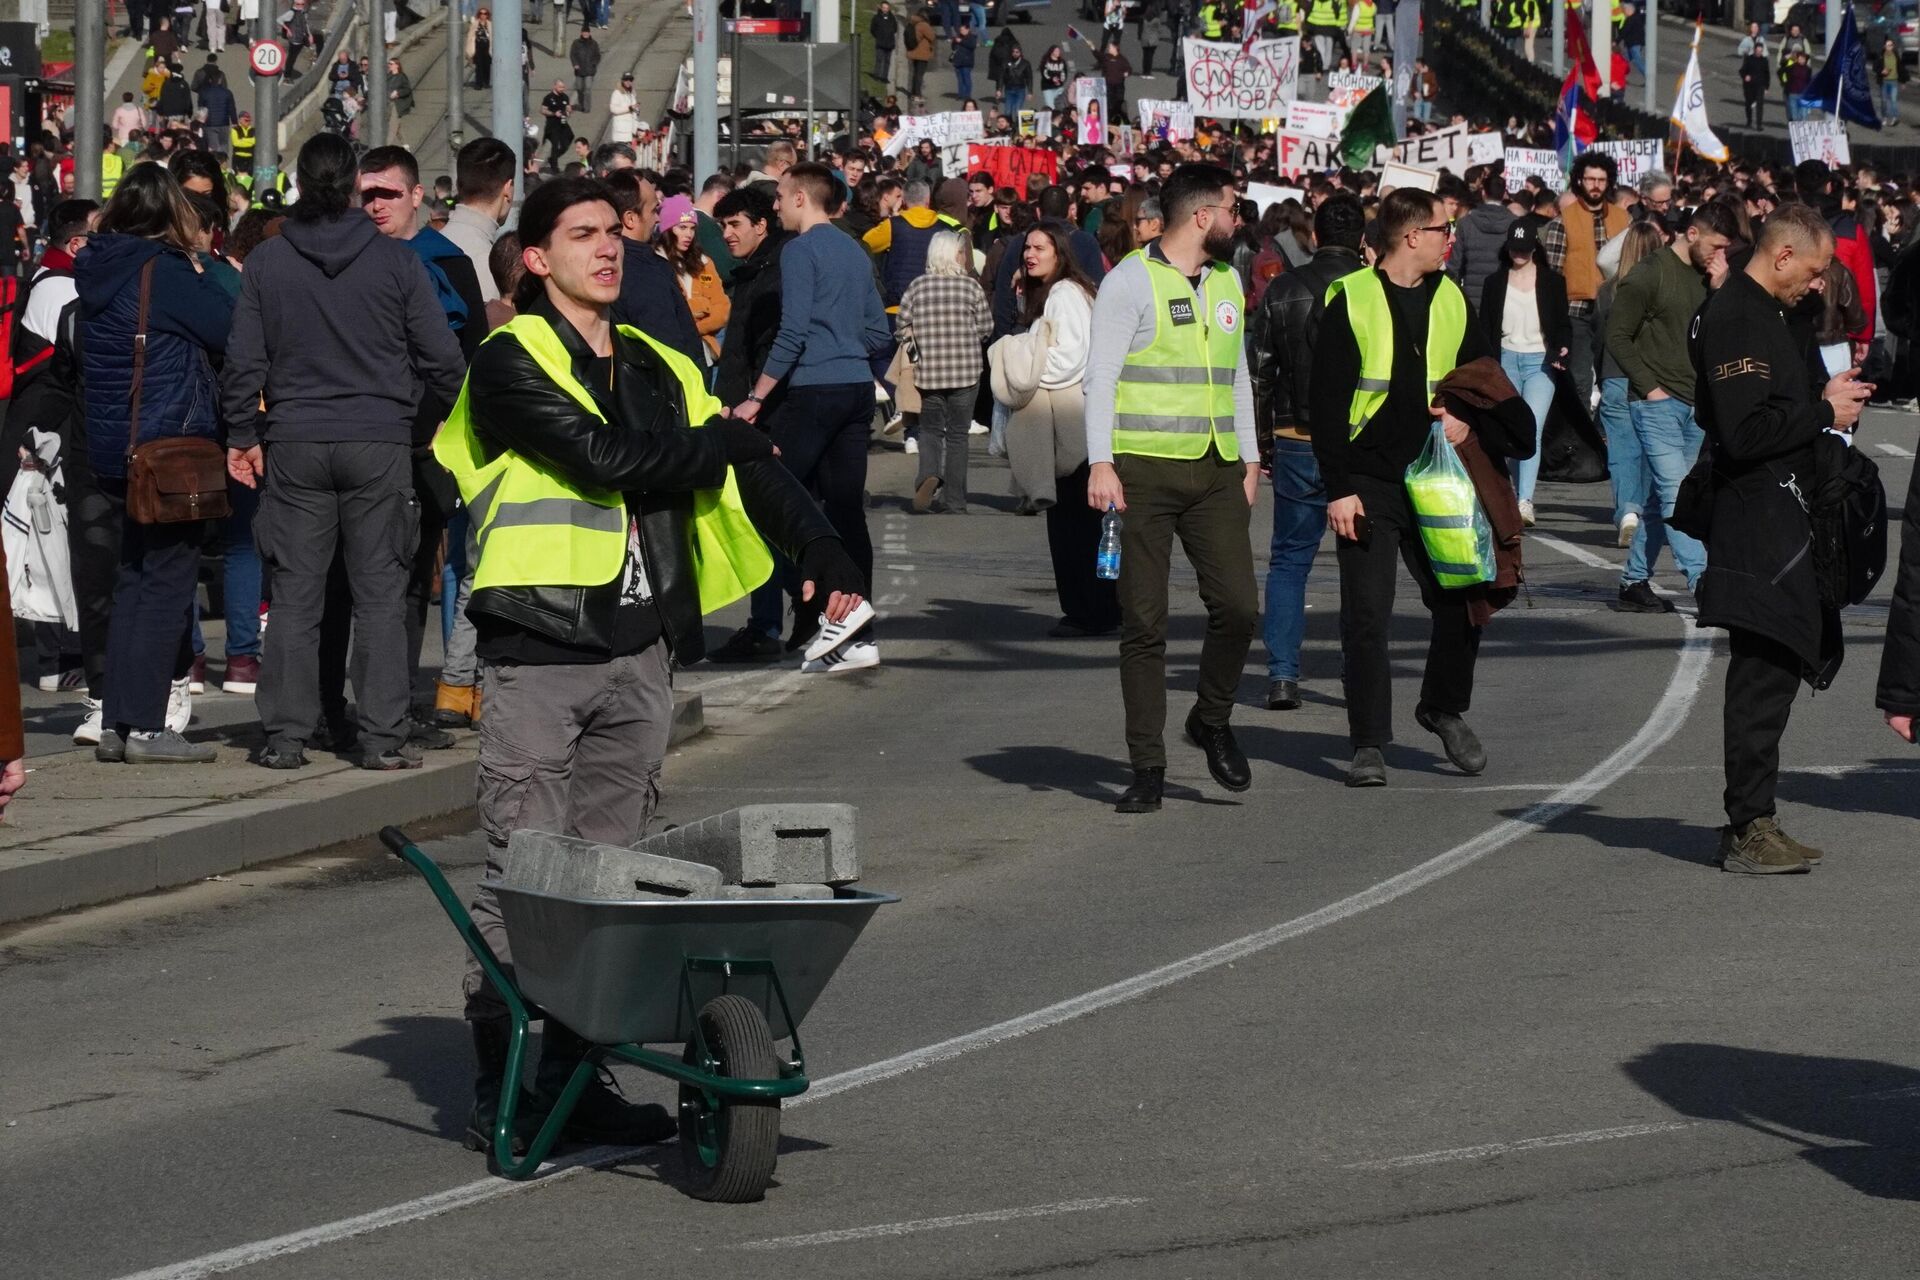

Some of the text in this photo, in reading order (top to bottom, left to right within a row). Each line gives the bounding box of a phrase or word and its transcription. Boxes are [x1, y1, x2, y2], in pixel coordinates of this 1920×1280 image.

[258, 49, 277, 65] 20
[1193, 41, 1293, 62] ФАКТЕТ
[1330, 73, 1394, 93] ЕКОНОМСИ
[1200, 89, 1286, 110] УМОВА
[1281, 130, 1461, 168] FAKLTET
[1507, 150, 1519, 162] НА
